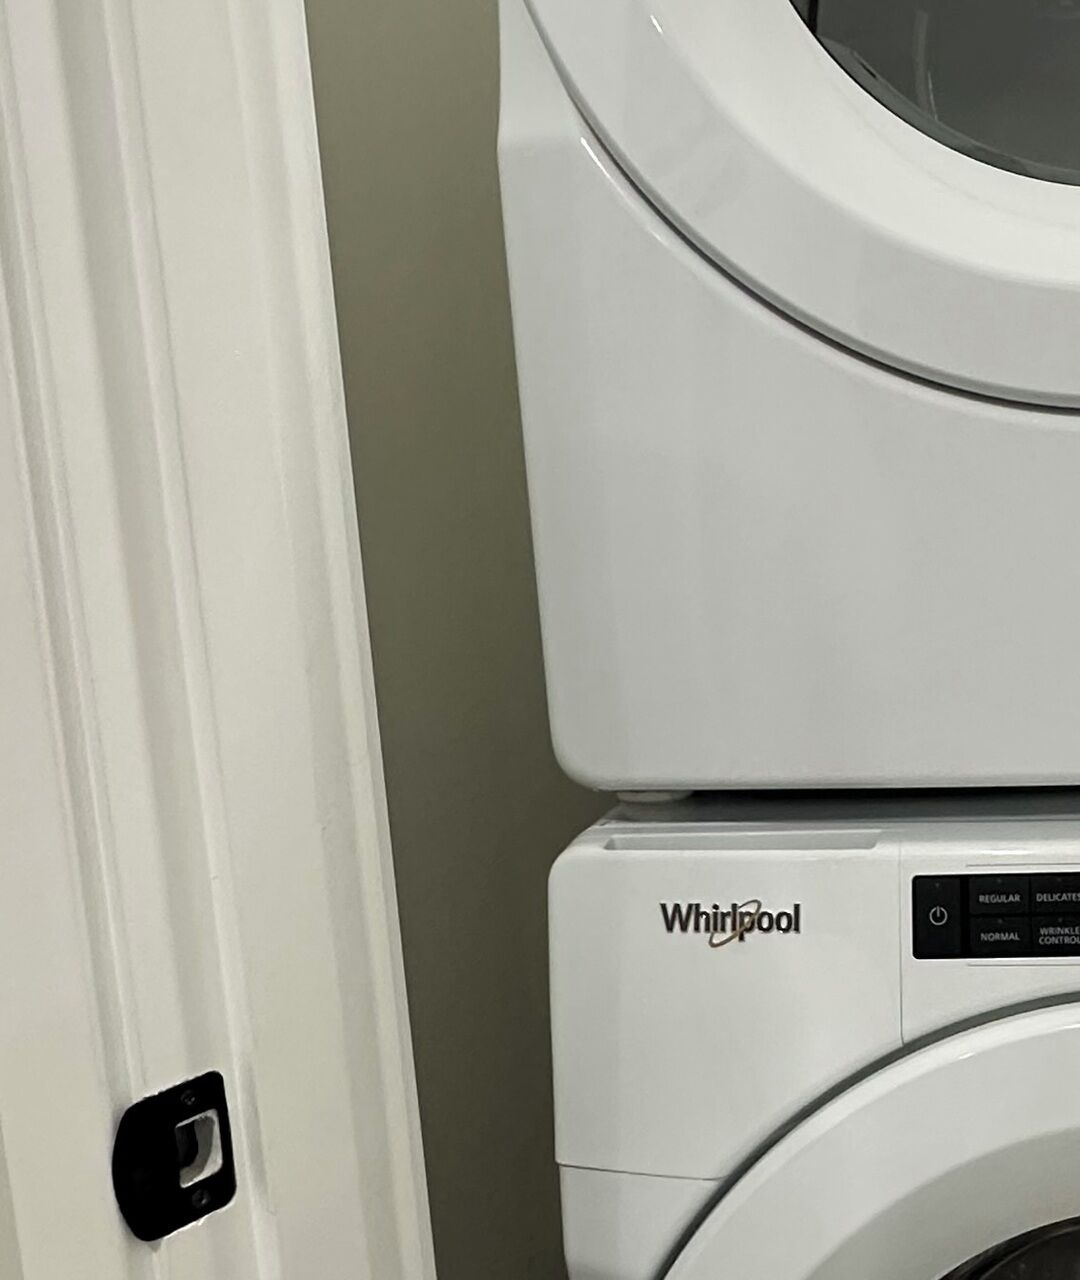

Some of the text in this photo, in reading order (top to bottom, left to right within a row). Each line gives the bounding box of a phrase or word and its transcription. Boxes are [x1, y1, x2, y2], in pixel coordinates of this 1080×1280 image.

[979, 894, 1021, 904] REGULAR
[660, 899, 801, 948] Whirlpool
[1039, 926, 1080, 936] WRINKLE
[981, 931, 1020, 942] NORMAL
